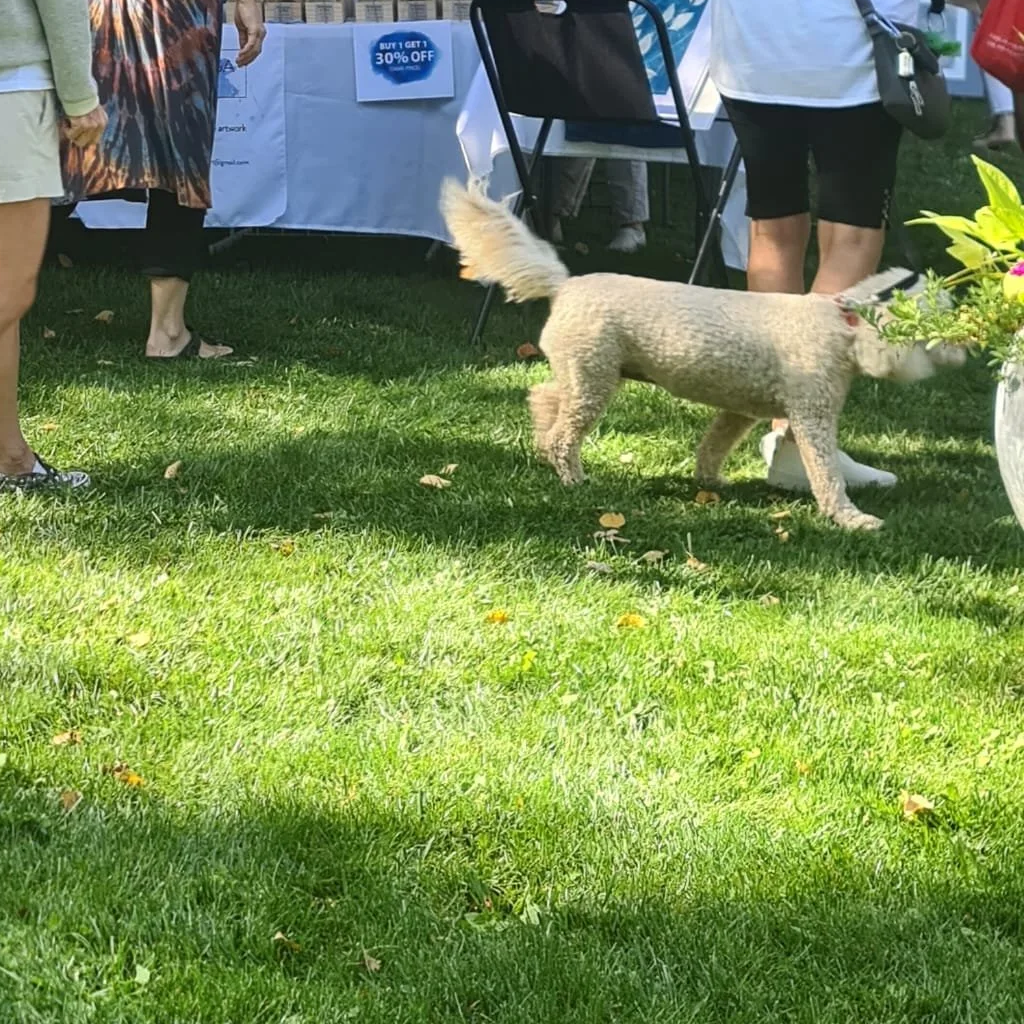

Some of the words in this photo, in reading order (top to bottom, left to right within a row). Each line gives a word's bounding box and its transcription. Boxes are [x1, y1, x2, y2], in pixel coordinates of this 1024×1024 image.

[379, 42, 396, 50] BUY
[404, 40, 421, 49] GET
[423, 40, 427, 48] 1
[376, 51, 409, 65] 30%
[410, 50, 434, 62] OFF
[218, 124, 247, 133] artwork
[211, 159, 249, 167] @gmail.com
